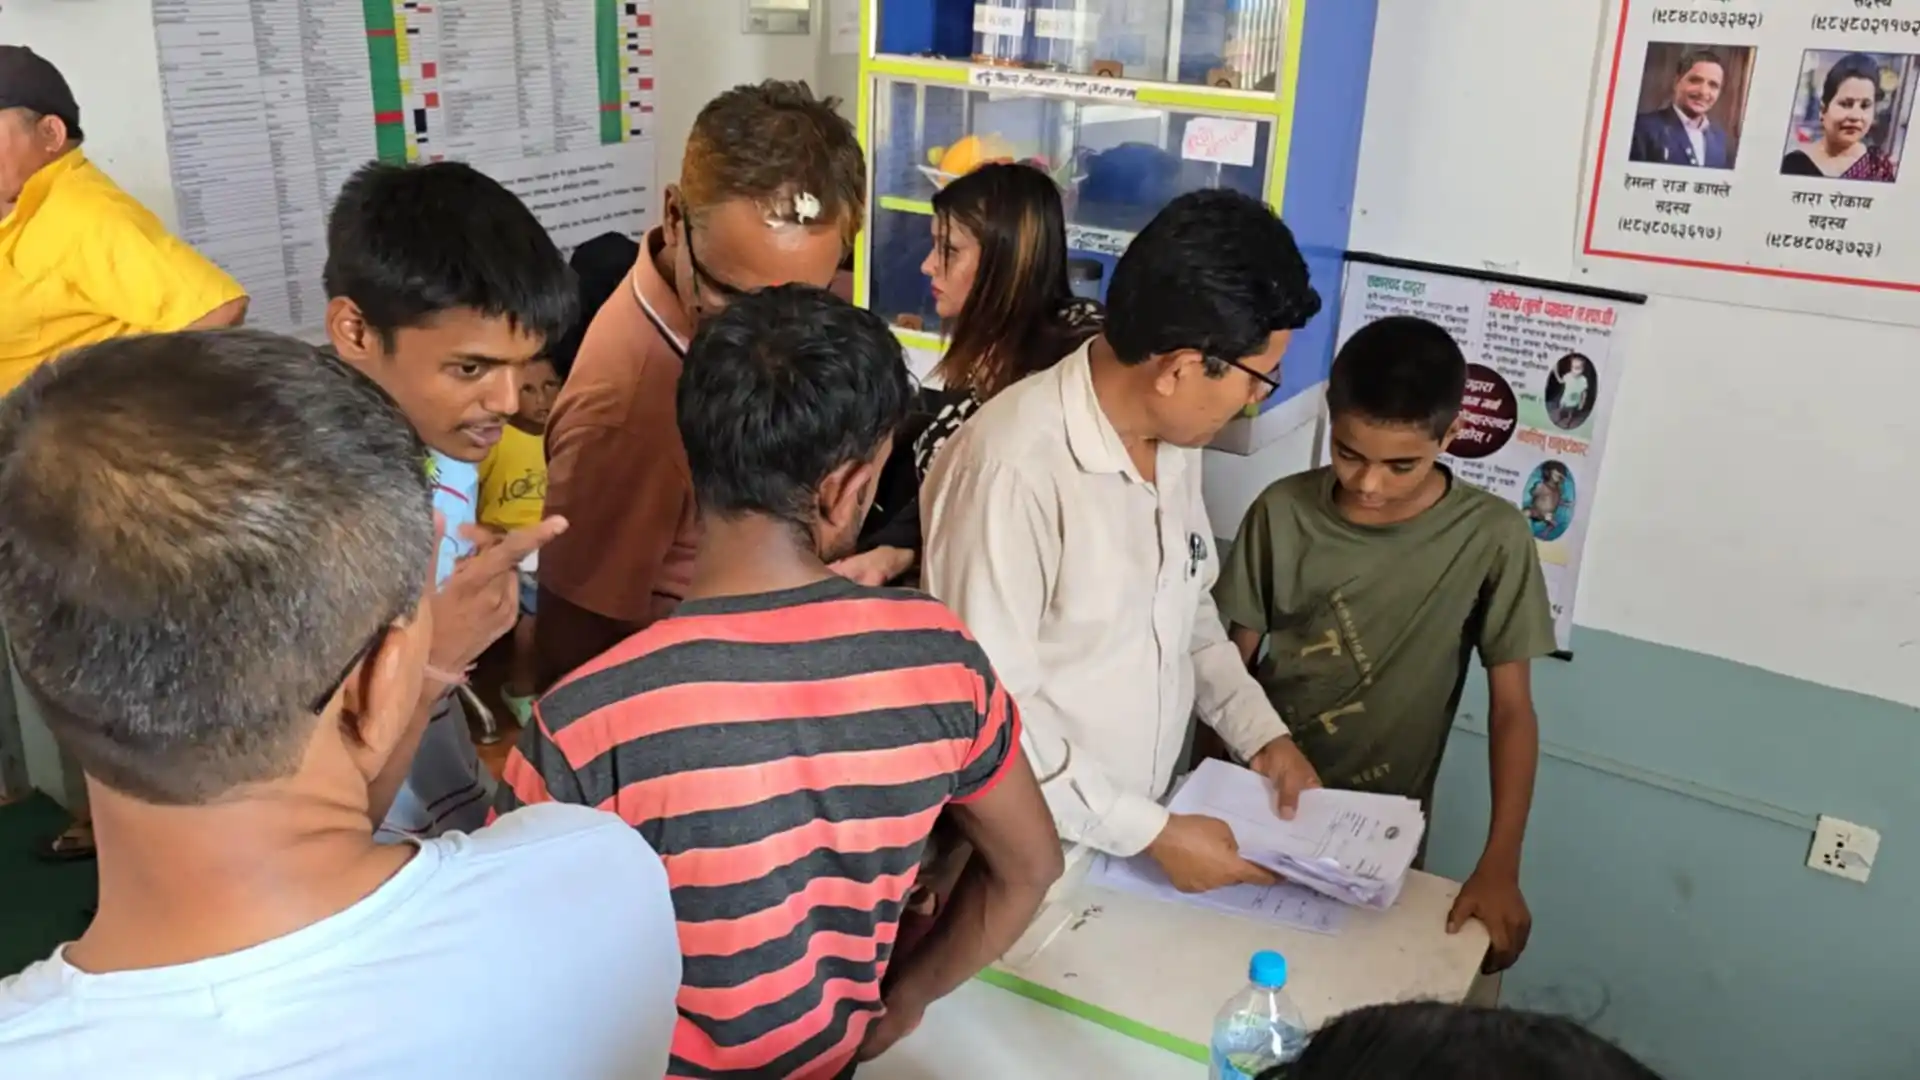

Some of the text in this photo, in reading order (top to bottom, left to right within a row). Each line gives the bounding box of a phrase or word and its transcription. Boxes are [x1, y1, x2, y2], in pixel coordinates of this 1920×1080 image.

[1624, 174, 1656, 191] हेमन्त
[1662, 179, 1688, 194] राज
[1792, 191, 1823, 207] तारा
[1656, 200, 1692, 215] सदस्य
[1809, 215, 1848, 230] सदस्य
